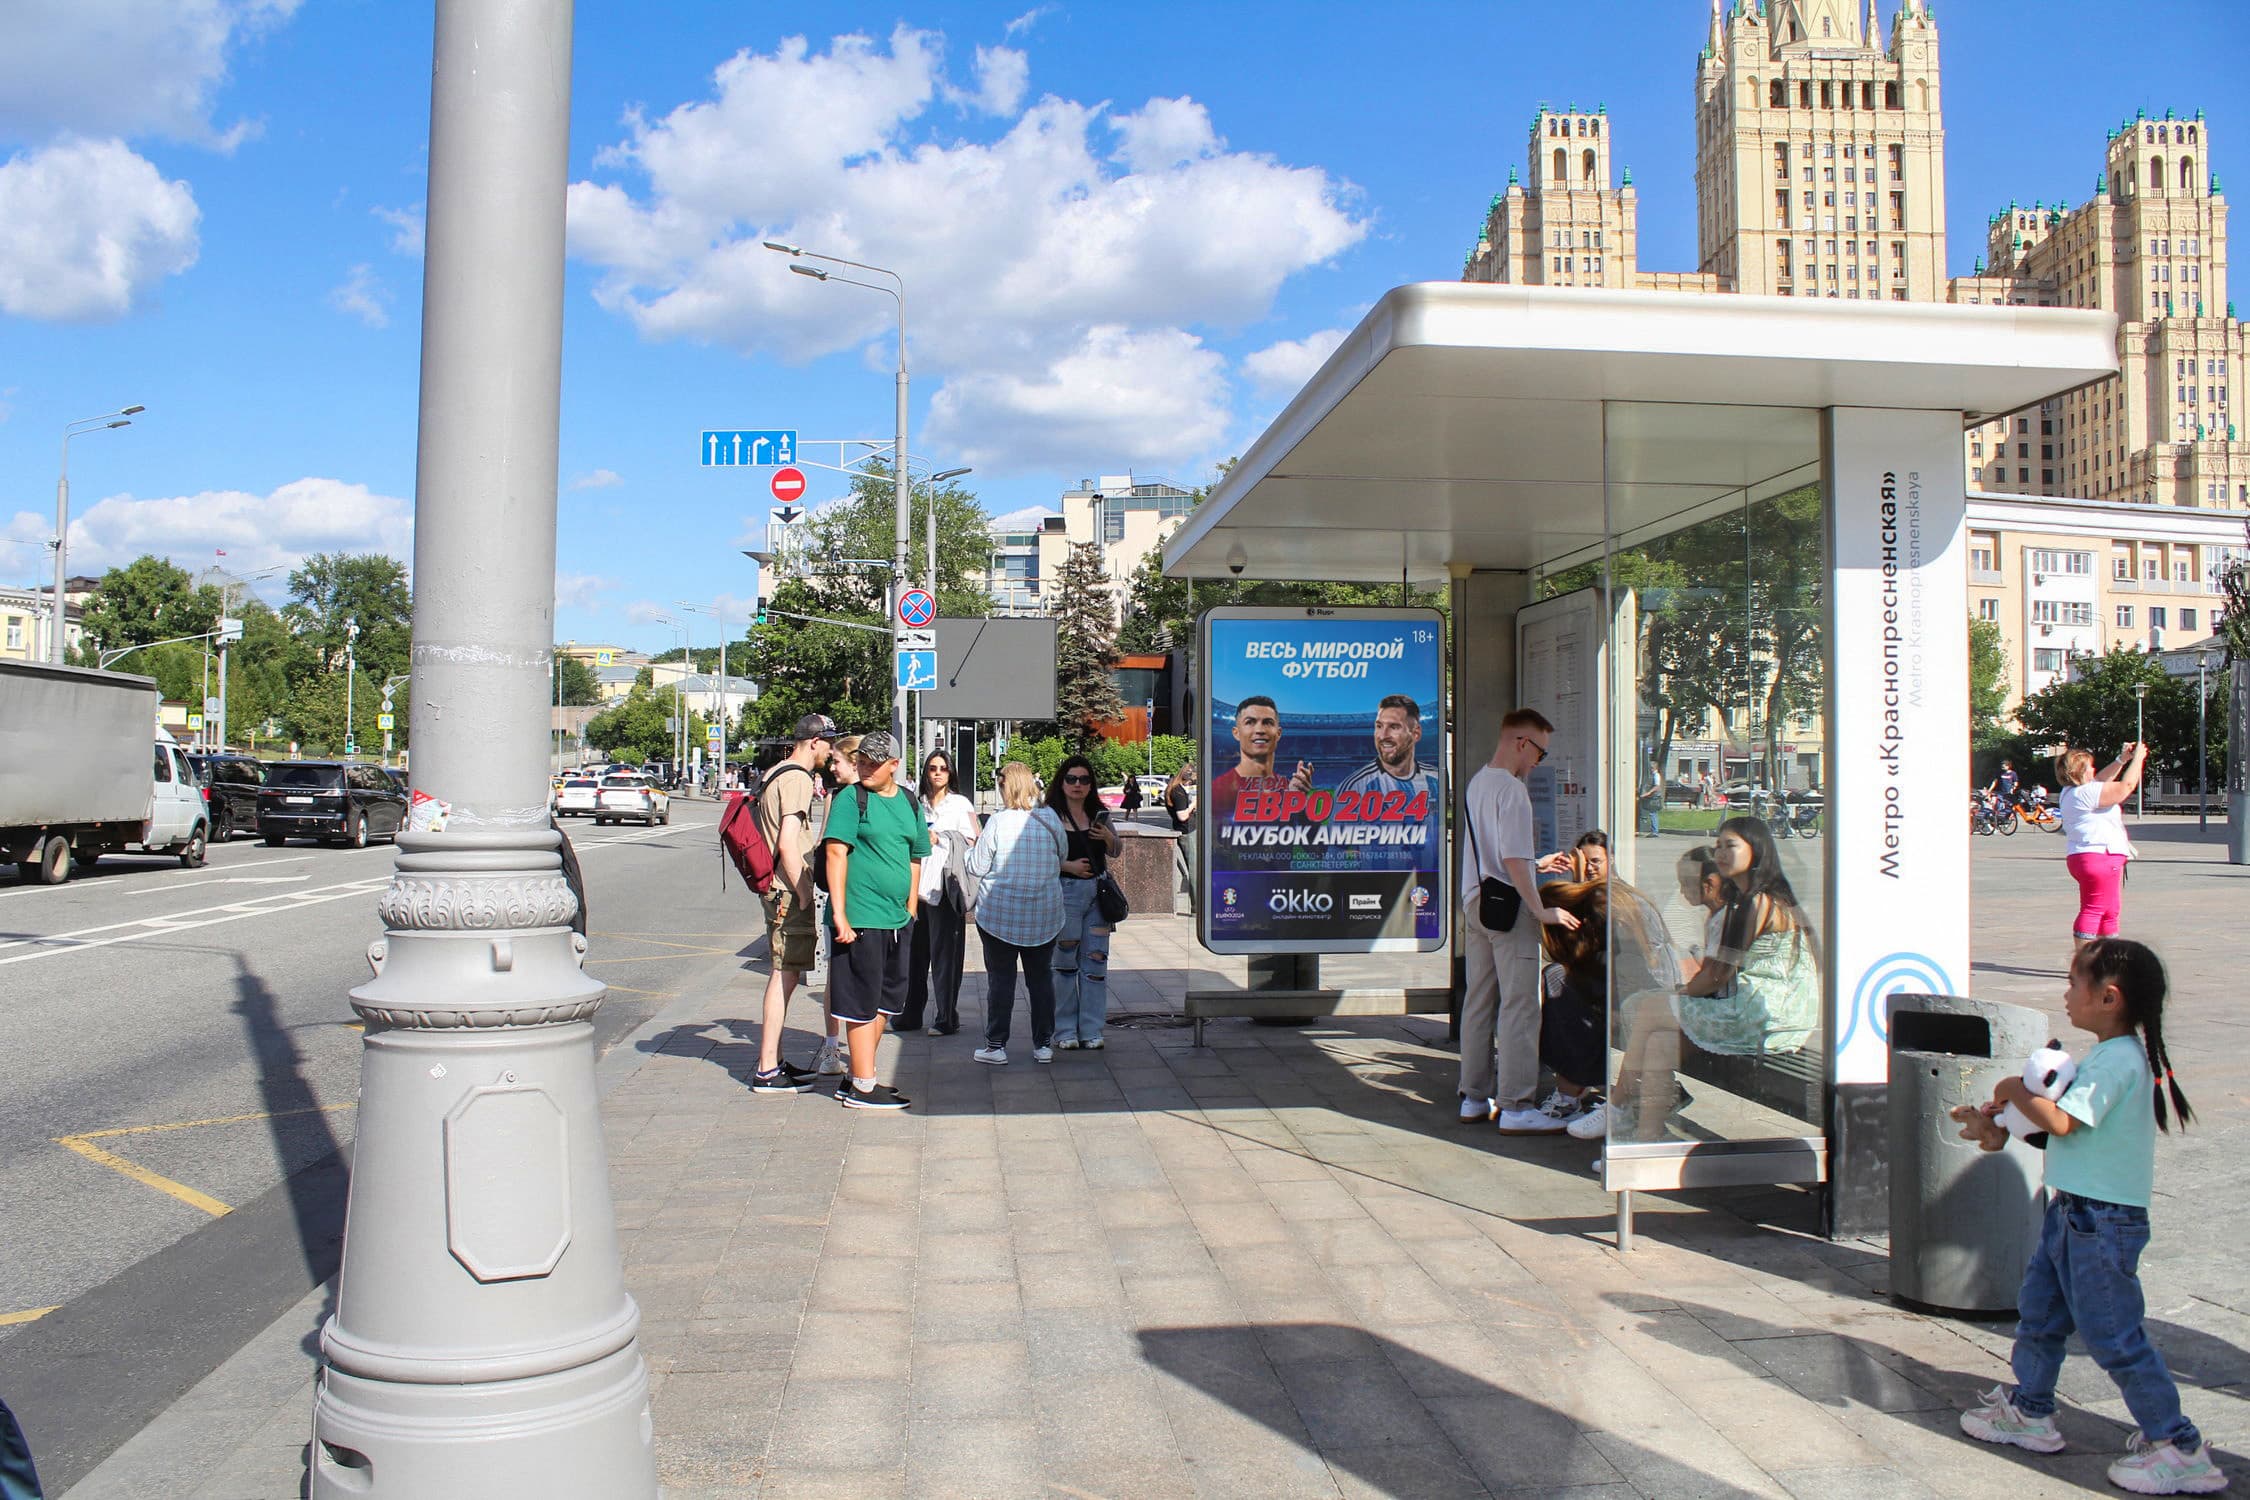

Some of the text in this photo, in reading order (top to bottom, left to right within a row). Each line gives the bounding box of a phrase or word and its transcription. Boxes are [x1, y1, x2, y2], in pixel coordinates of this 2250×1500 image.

[1906, 471, 1923, 708] Metro Krasnopresnenskaya
[1245, 637, 1405, 660] ВЕСЬ МИРОВОЙ
[1412, 630, 1434, 644] 18+
[1281, 661, 1369, 679] ФУТБОЛ
[1880, 470, 1904, 879] Метро «Краснопресненская»
[1233, 789, 1430, 823] ЕВРО 2024
[1231, 825, 1310, 846] КУБОК
[1311, 824, 1428, 846] АМЕРИКИ
